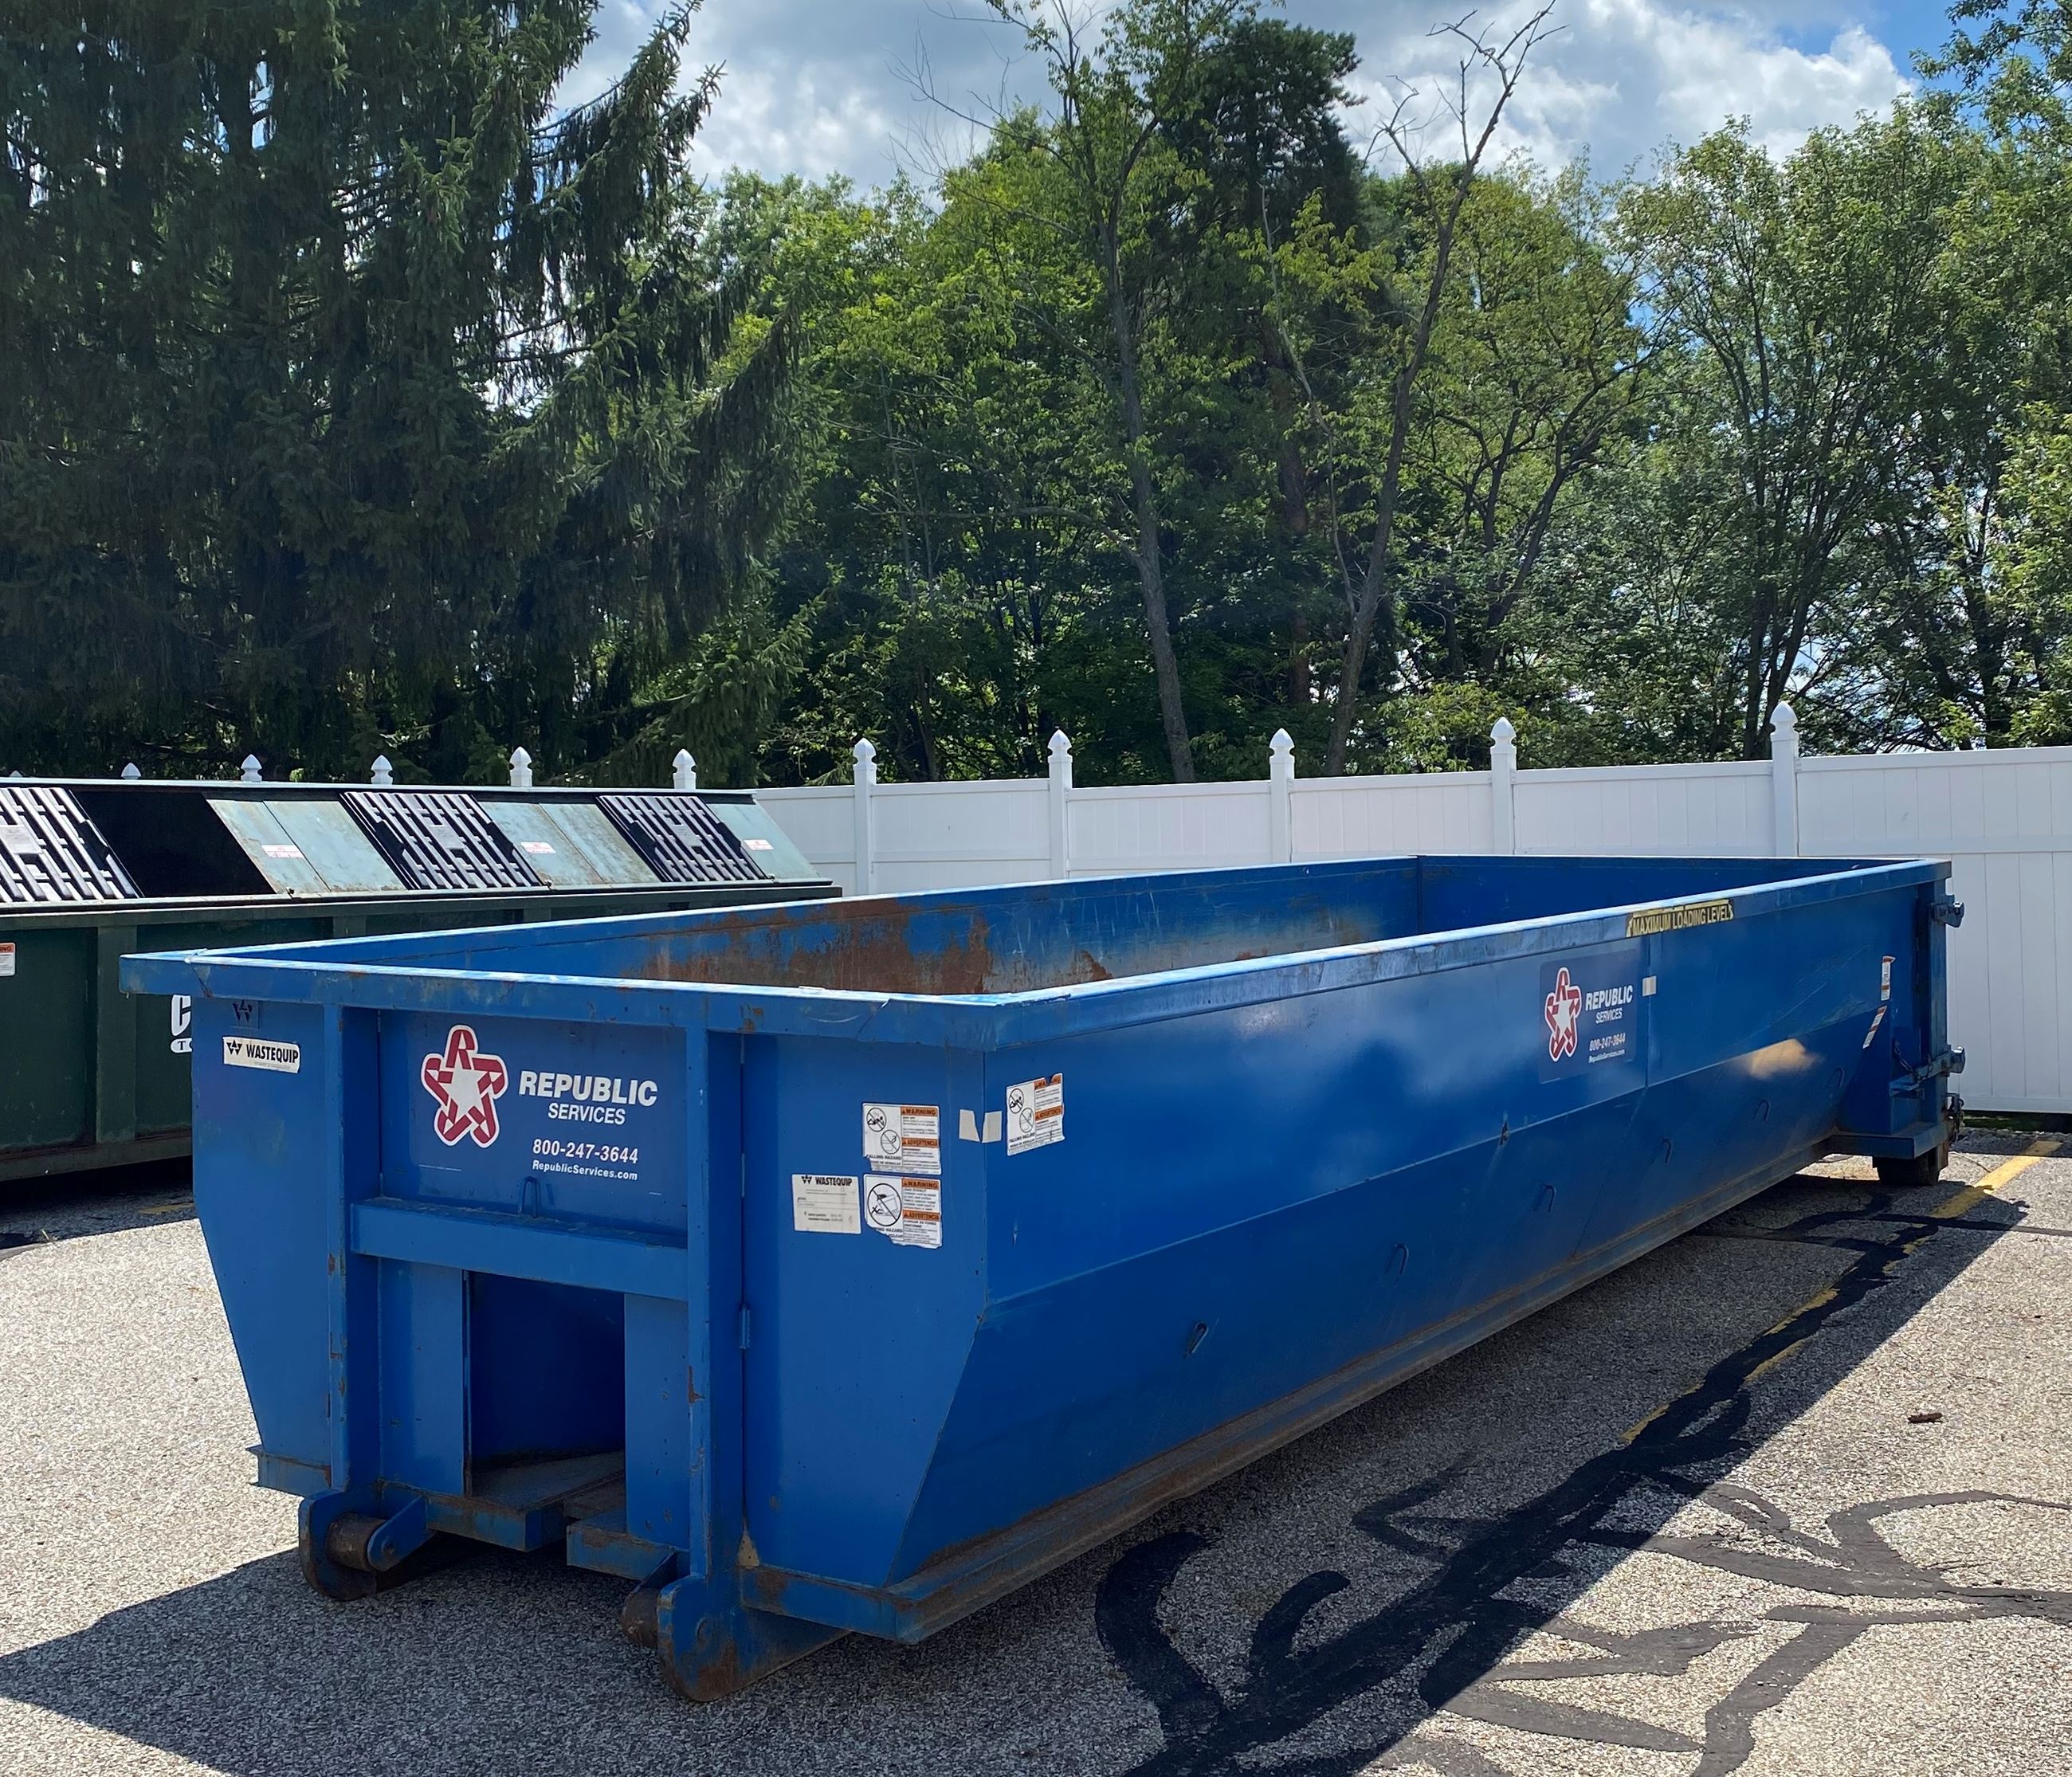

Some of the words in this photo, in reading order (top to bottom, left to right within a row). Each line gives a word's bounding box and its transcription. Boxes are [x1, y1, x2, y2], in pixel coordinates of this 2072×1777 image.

[1633, 913, 1671, 936] MAXIMUM
[1673, 908, 1705, 929] LOADING
[1586, 985, 1633, 1011] REPUBLIC
[1595, 1007, 1623, 1024] SERVICES
[245, 1044, 299, 1064] WASTEQUIP
[519, 1070, 658, 1107] REPUBLIC
[547, 1102, 626, 1125] SERVICES
[532, 1139, 638, 1164] 800-247-3644
[532, 1160, 638, 1181] RepublicServices.com
[814, 1177, 853, 1186] WASTEQUIP
